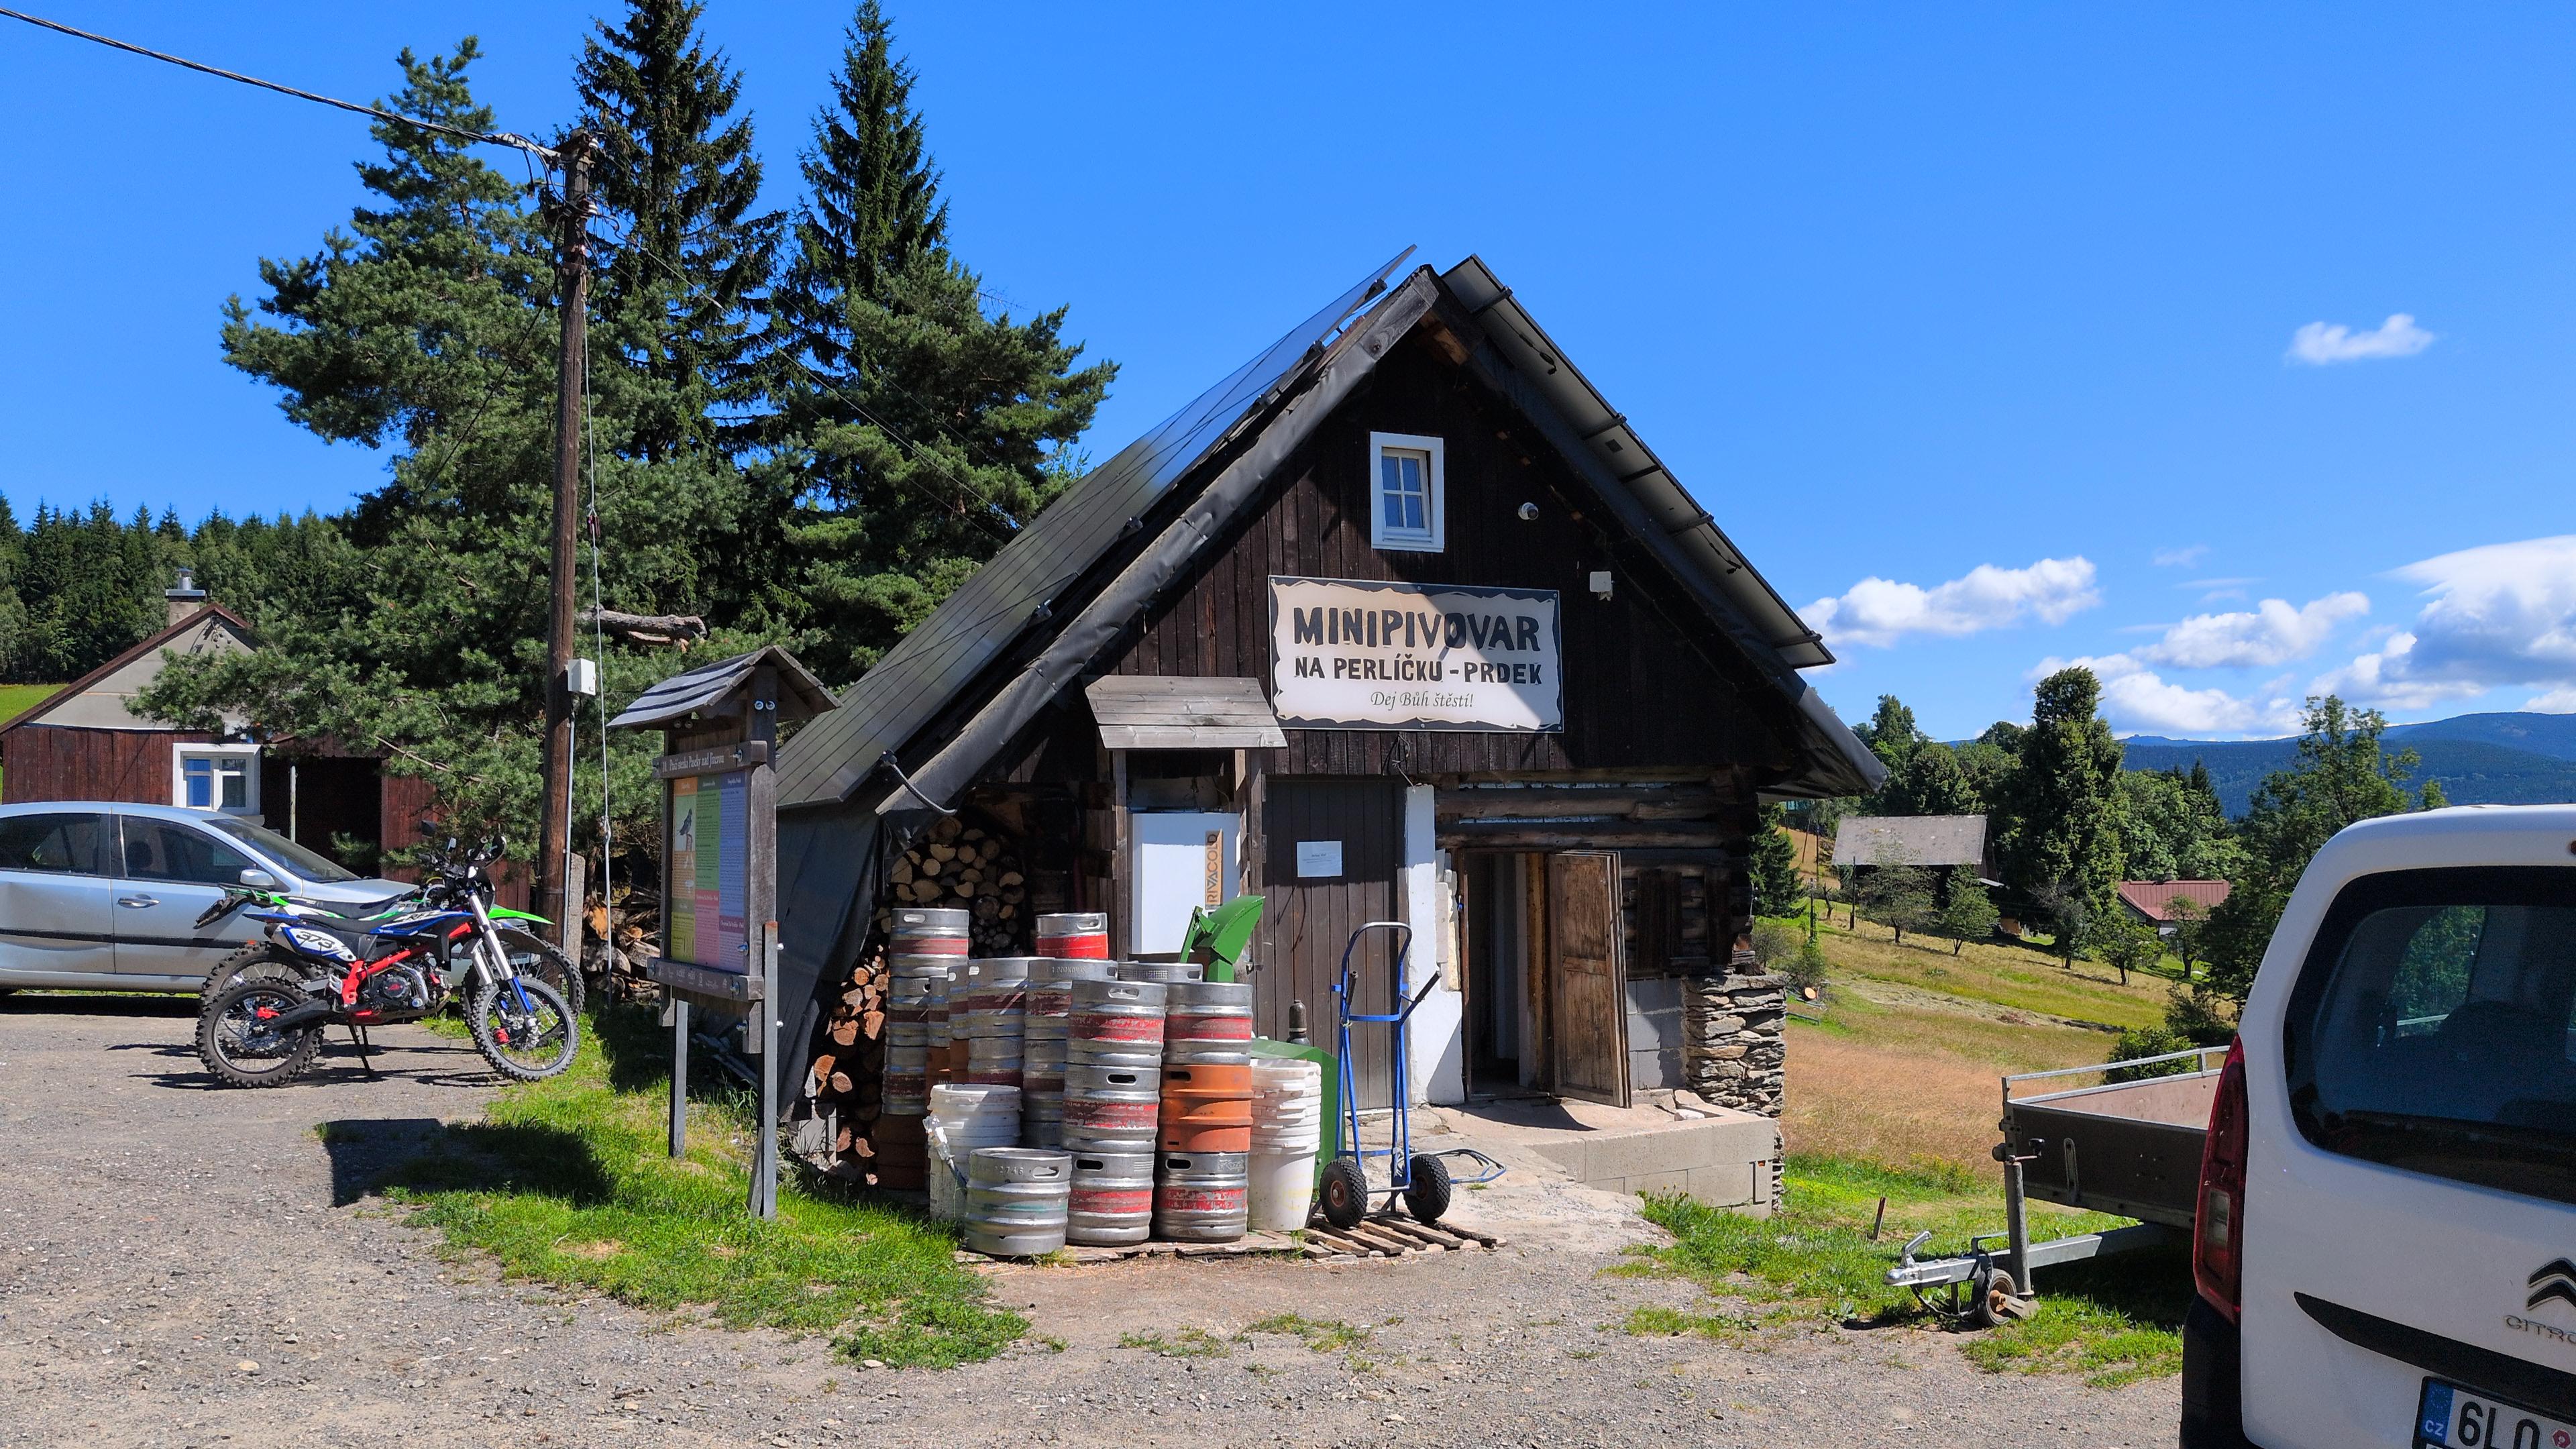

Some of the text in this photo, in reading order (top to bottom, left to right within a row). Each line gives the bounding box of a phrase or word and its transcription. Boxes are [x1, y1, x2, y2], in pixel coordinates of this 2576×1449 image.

[1293, 606, 1541, 651] MINIPIVOVAR
[1295, 656, 1325, 679] NA
[1334, 653, 1443, 682] PERLÍČKU
[1464, 661, 1542, 684] PRDEK
[1371, 691, 1474, 711] Dej Bůh štěstí!
[1207, 834, 1218, 903] RIVACOLD
[296, 930, 335, 949] 373
[2425, 1419, 2444, 1437] CZ
